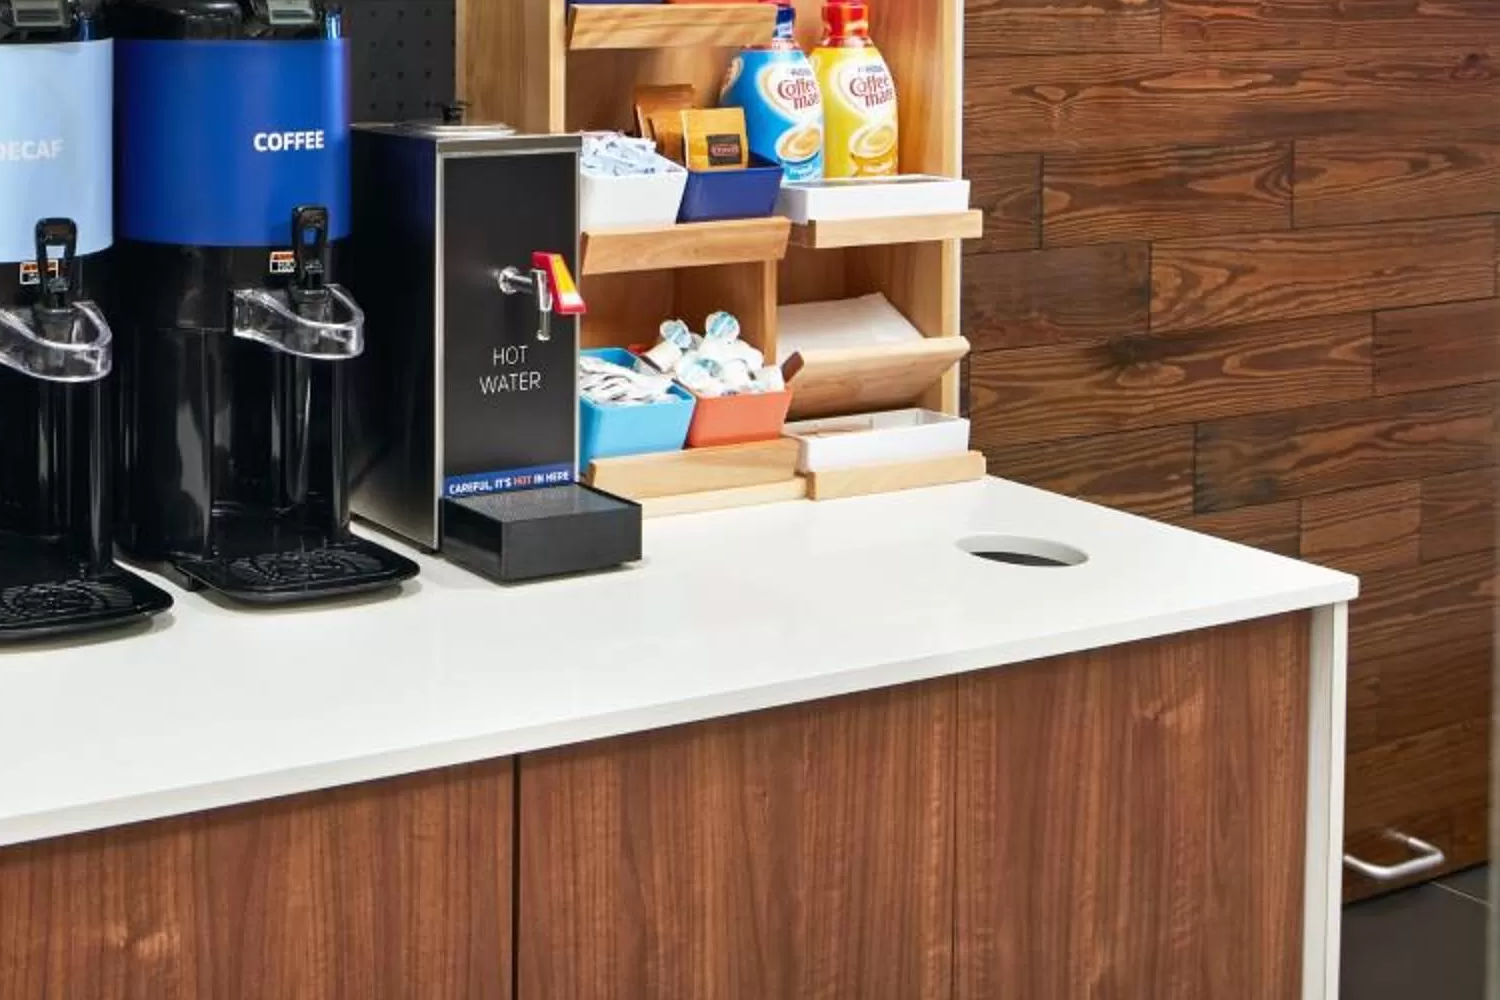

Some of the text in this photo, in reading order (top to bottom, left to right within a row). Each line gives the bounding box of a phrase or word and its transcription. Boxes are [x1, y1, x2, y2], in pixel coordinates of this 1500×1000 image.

[253, 130, 325, 152] COFFEE
[493, 345, 529, 367] HOT
[479, 371, 541, 395] WATER
